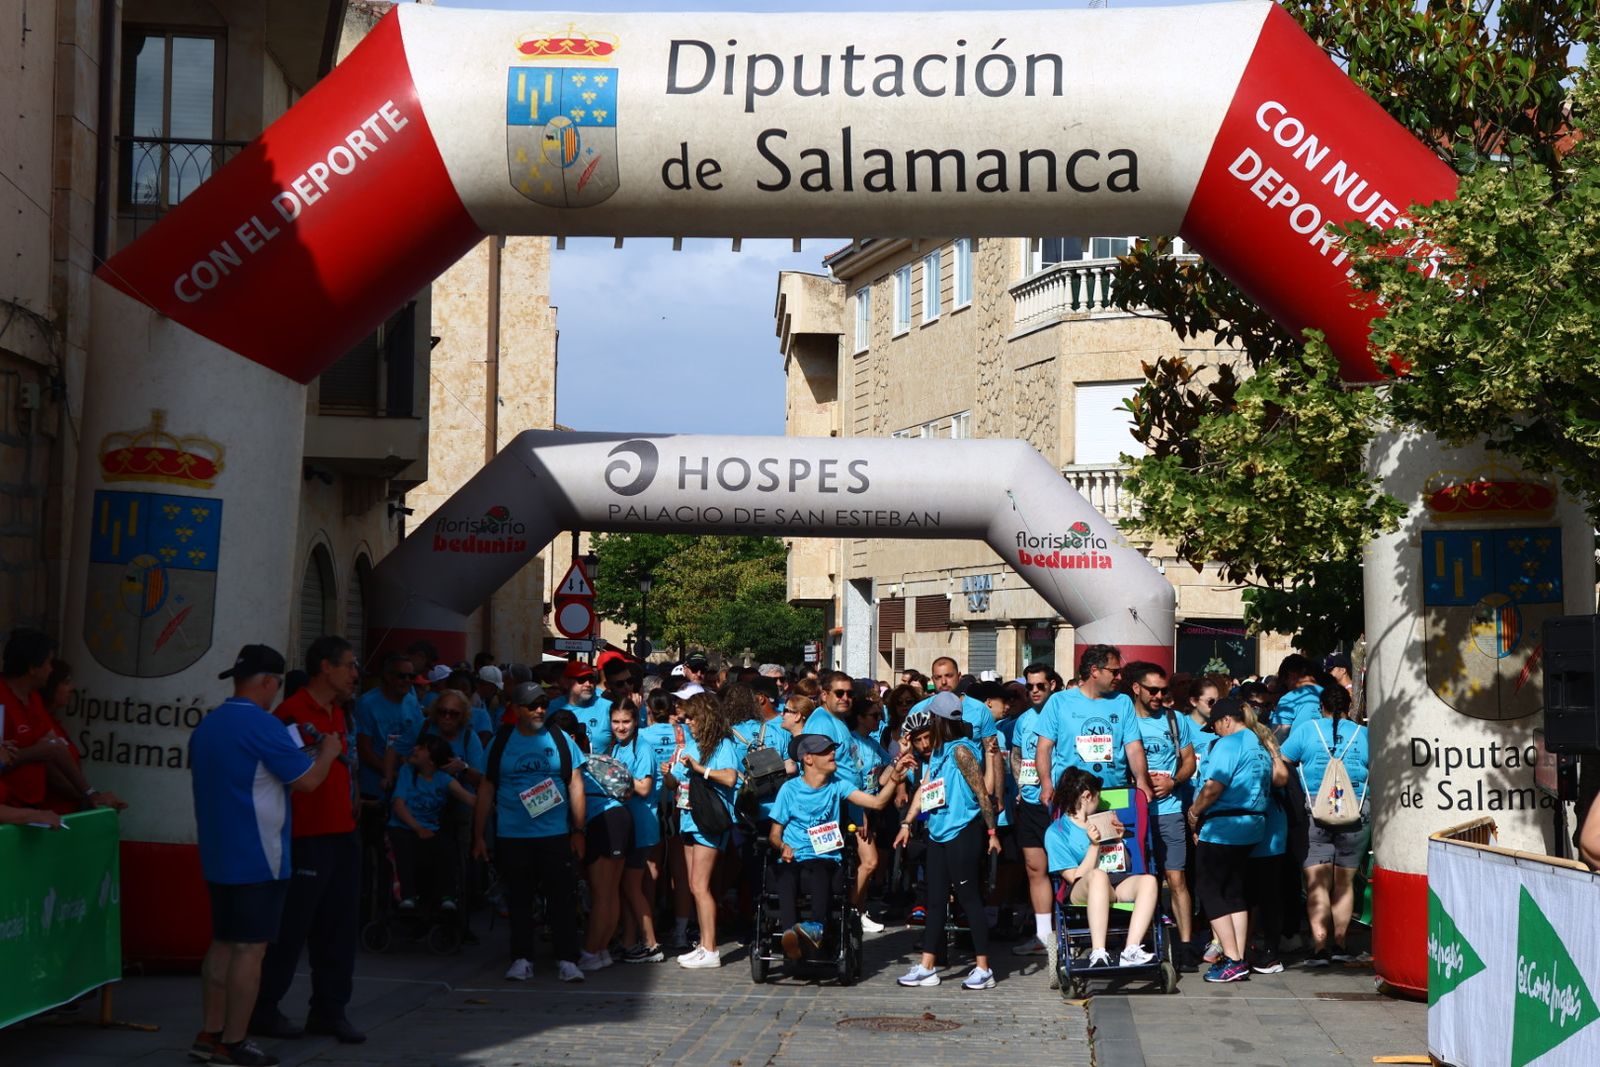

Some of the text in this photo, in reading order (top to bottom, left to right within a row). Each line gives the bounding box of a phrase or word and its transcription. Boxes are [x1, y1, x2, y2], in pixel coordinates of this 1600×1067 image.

[665, 38, 1064, 113] Diputación
[1255, 100, 1331, 172] CON
[661, 125, 1141, 193] de Salamanca
[173, 99, 409, 304] CON EL DEPORTE
[678, 456, 871, 495] HOSPES
[435, 517, 526, 535] floristería
[608, 503, 941, 528] PALACIO DE SAN ESTEBAN
[432, 534, 528, 554] bedunia
[1016, 530, 1108, 549] floristería
[1017, 549, 1113, 569] bedunia
[65, 688, 204, 729] Diputació
[78, 729, 189, 770] Salama
[1411, 737, 1537, 776] Diputac
[1400, 779, 1556, 811] de Salama
[817, 831, 837, 845] 1501
[1517, 955, 1582, 1028] El Corte Inglés
